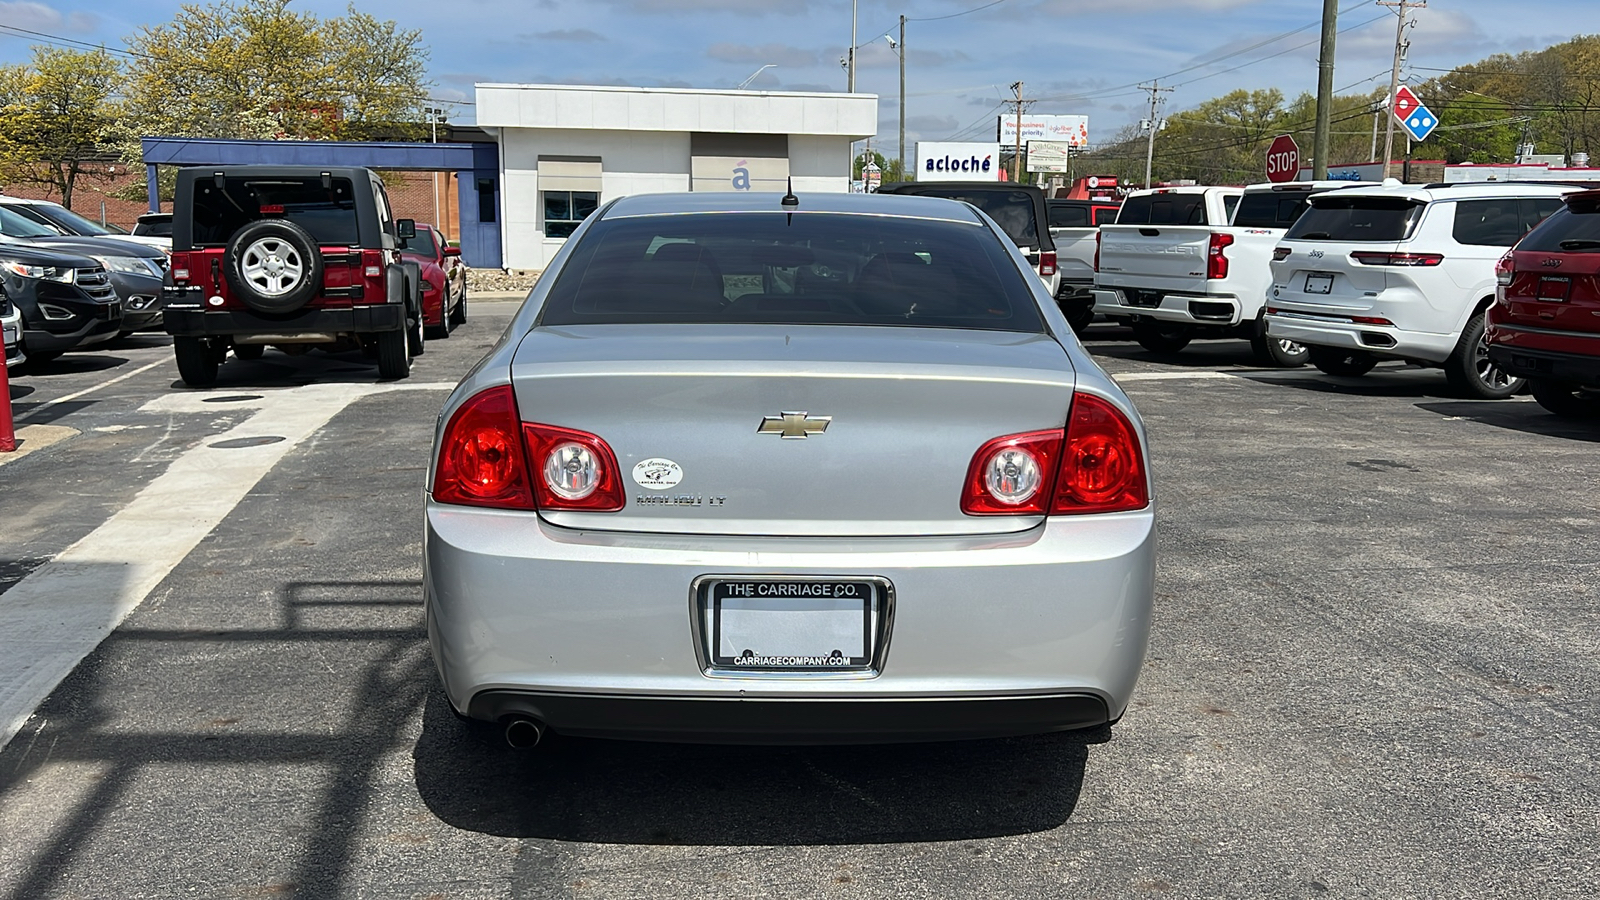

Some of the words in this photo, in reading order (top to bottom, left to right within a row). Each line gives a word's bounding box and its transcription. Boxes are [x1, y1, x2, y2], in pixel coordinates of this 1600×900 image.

[926, 155, 991, 172] acloché
[1268, 151, 1297, 174] STOP
[1102, 243, 1199, 255] CHEVROLET
[636, 494, 702, 506] MALIBU
[709, 494, 727, 506] LT
[726, 584, 755, 595] THE
[758, 584, 831, 595] CARRIAGE
[836, 585, 859, 596] CO.
[734, 656, 850, 666] CARRIAGECOMPANY.COM
